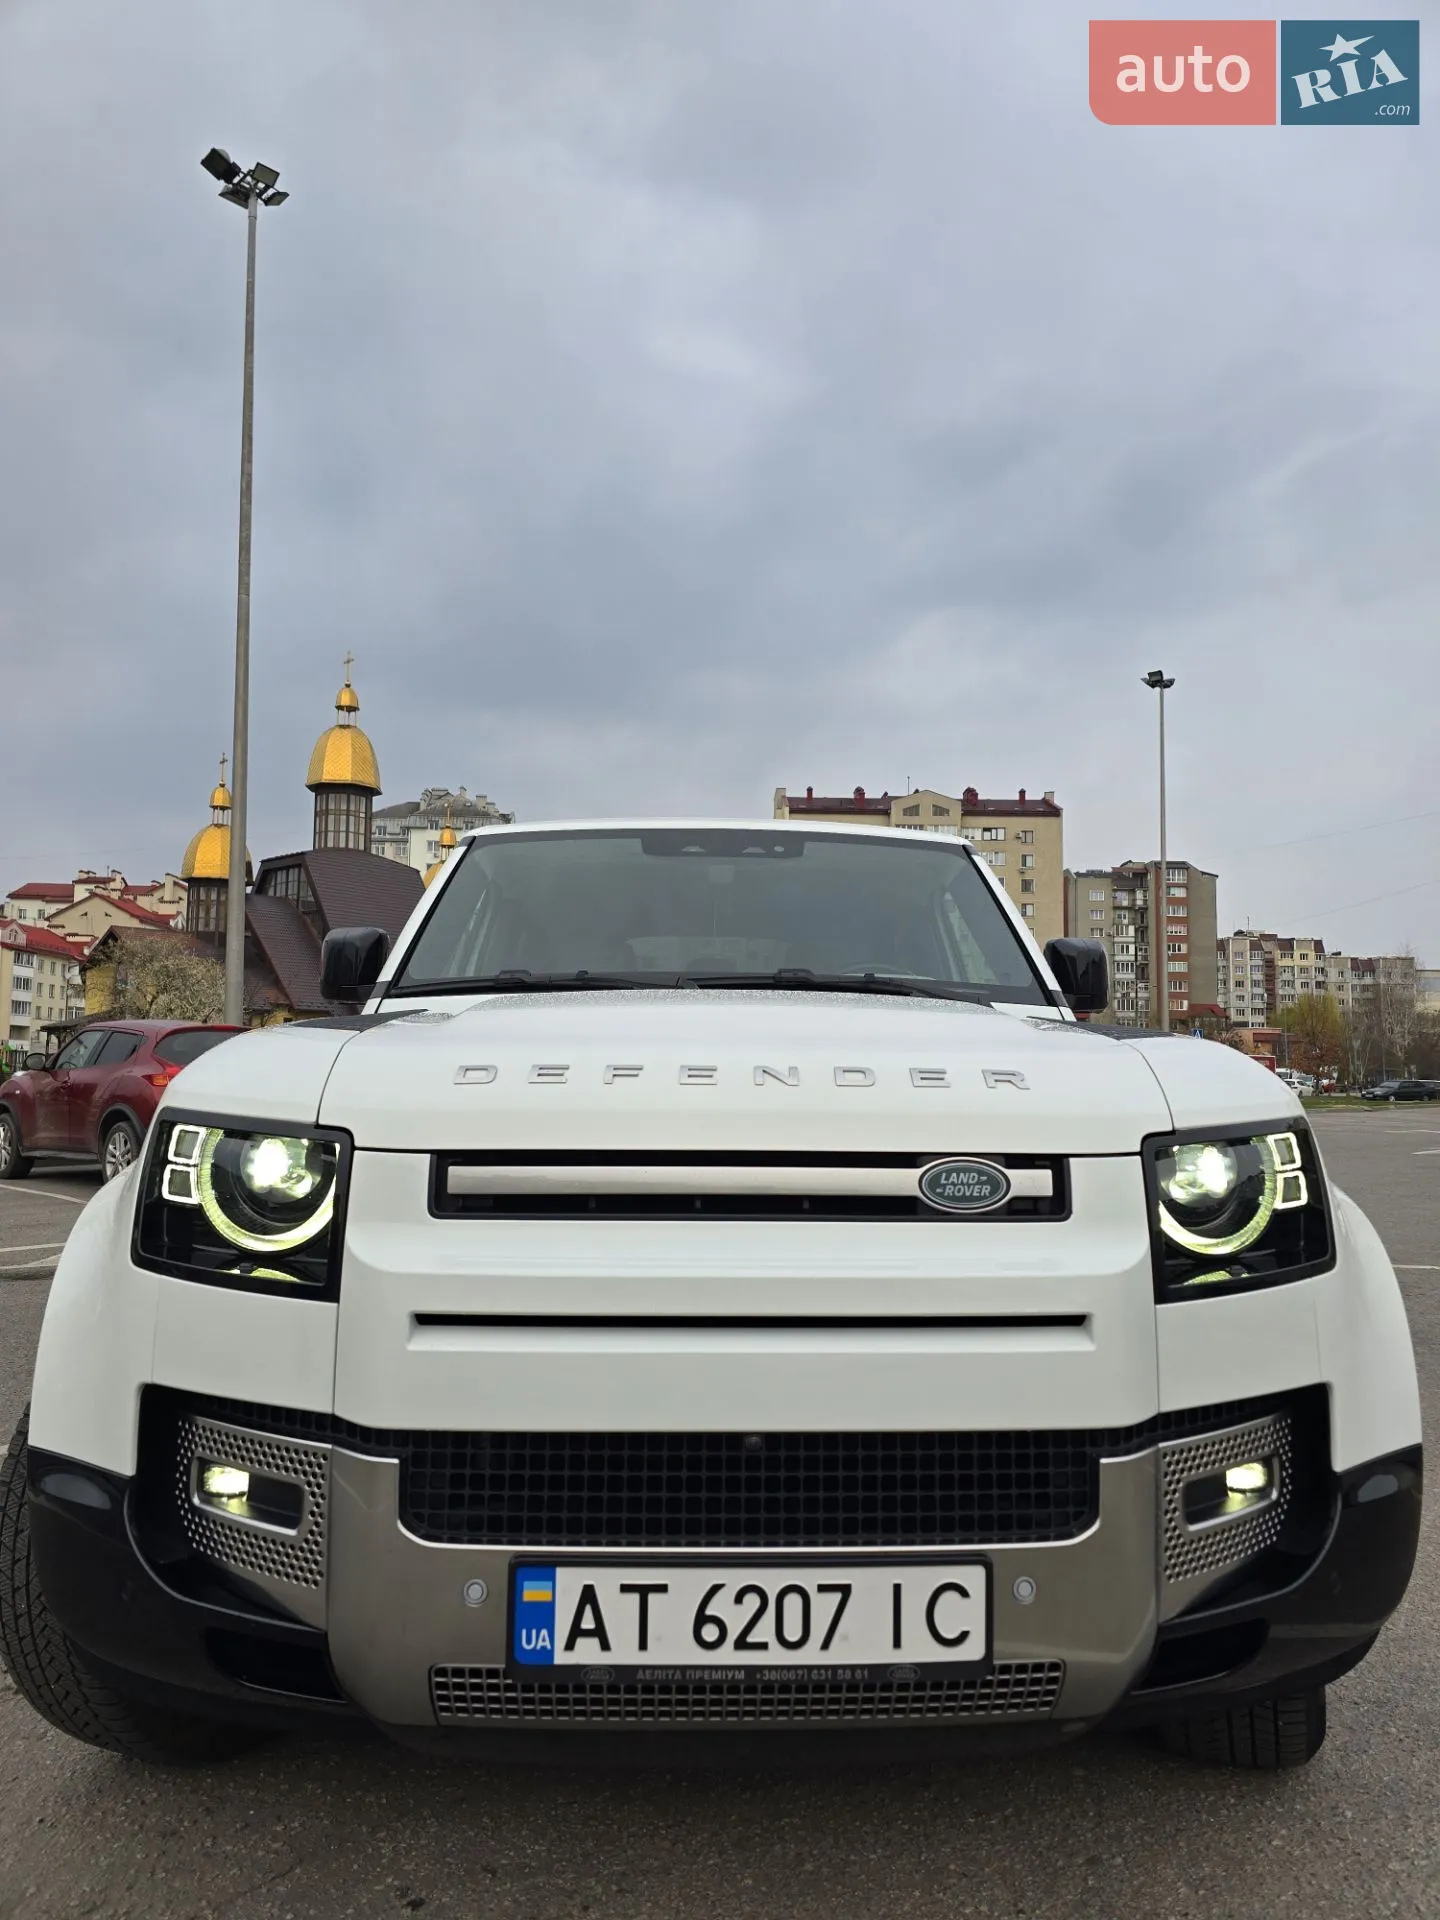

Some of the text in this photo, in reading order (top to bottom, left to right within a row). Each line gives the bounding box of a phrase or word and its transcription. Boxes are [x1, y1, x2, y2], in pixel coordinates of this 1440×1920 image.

[453, 1064, 1030, 1090] DEFENDER
[563, 1583, 669, 1652] AT
[692, 1583, 852, 1652] 6207
[521, 1628, 551, 1650] UA
[685, 1668, 745, 1681] ПРЕМІУМ
